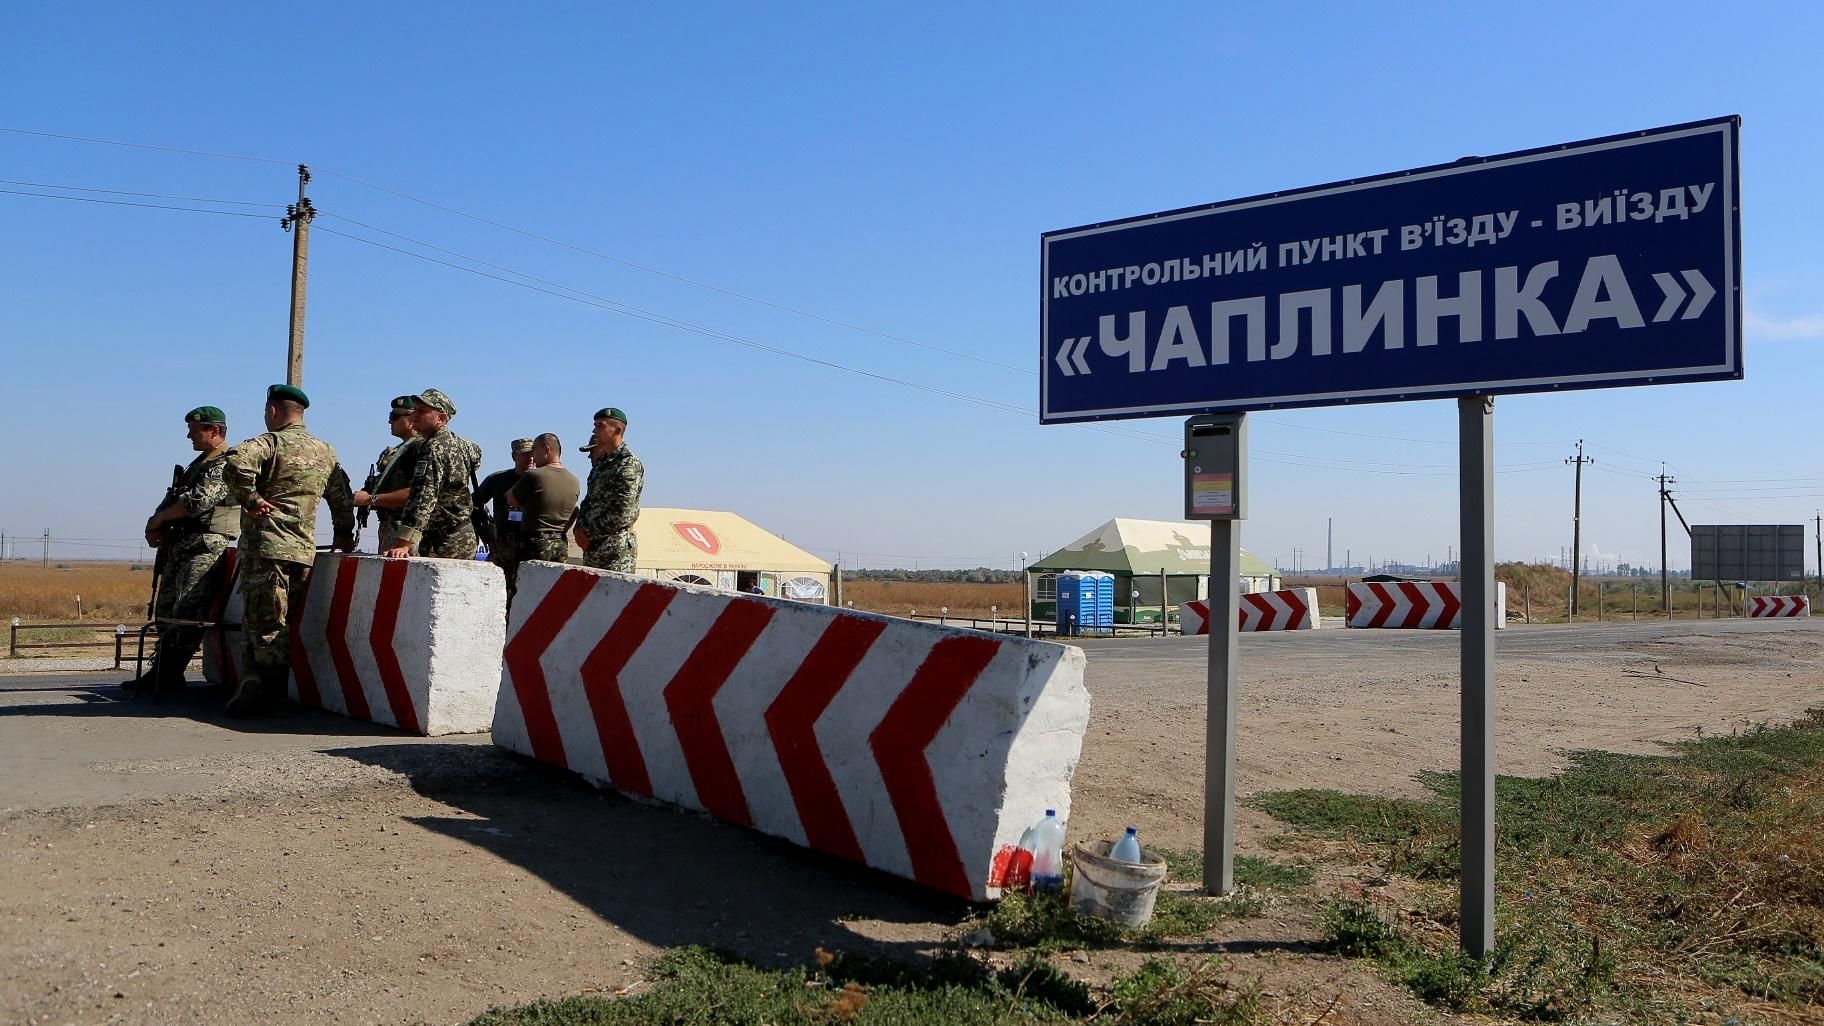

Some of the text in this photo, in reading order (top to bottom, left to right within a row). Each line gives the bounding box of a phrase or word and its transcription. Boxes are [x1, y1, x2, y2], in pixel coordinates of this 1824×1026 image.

[1053, 242, 1267, 299] КОНТРОЛЬНИЙ
[1278, 228, 1389, 268] ПУНКТ
[1556, 183, 1716, 231] ВИЇЗДУ
[1056, 255, 1716, 377] «ЧАПЛИНКА»
